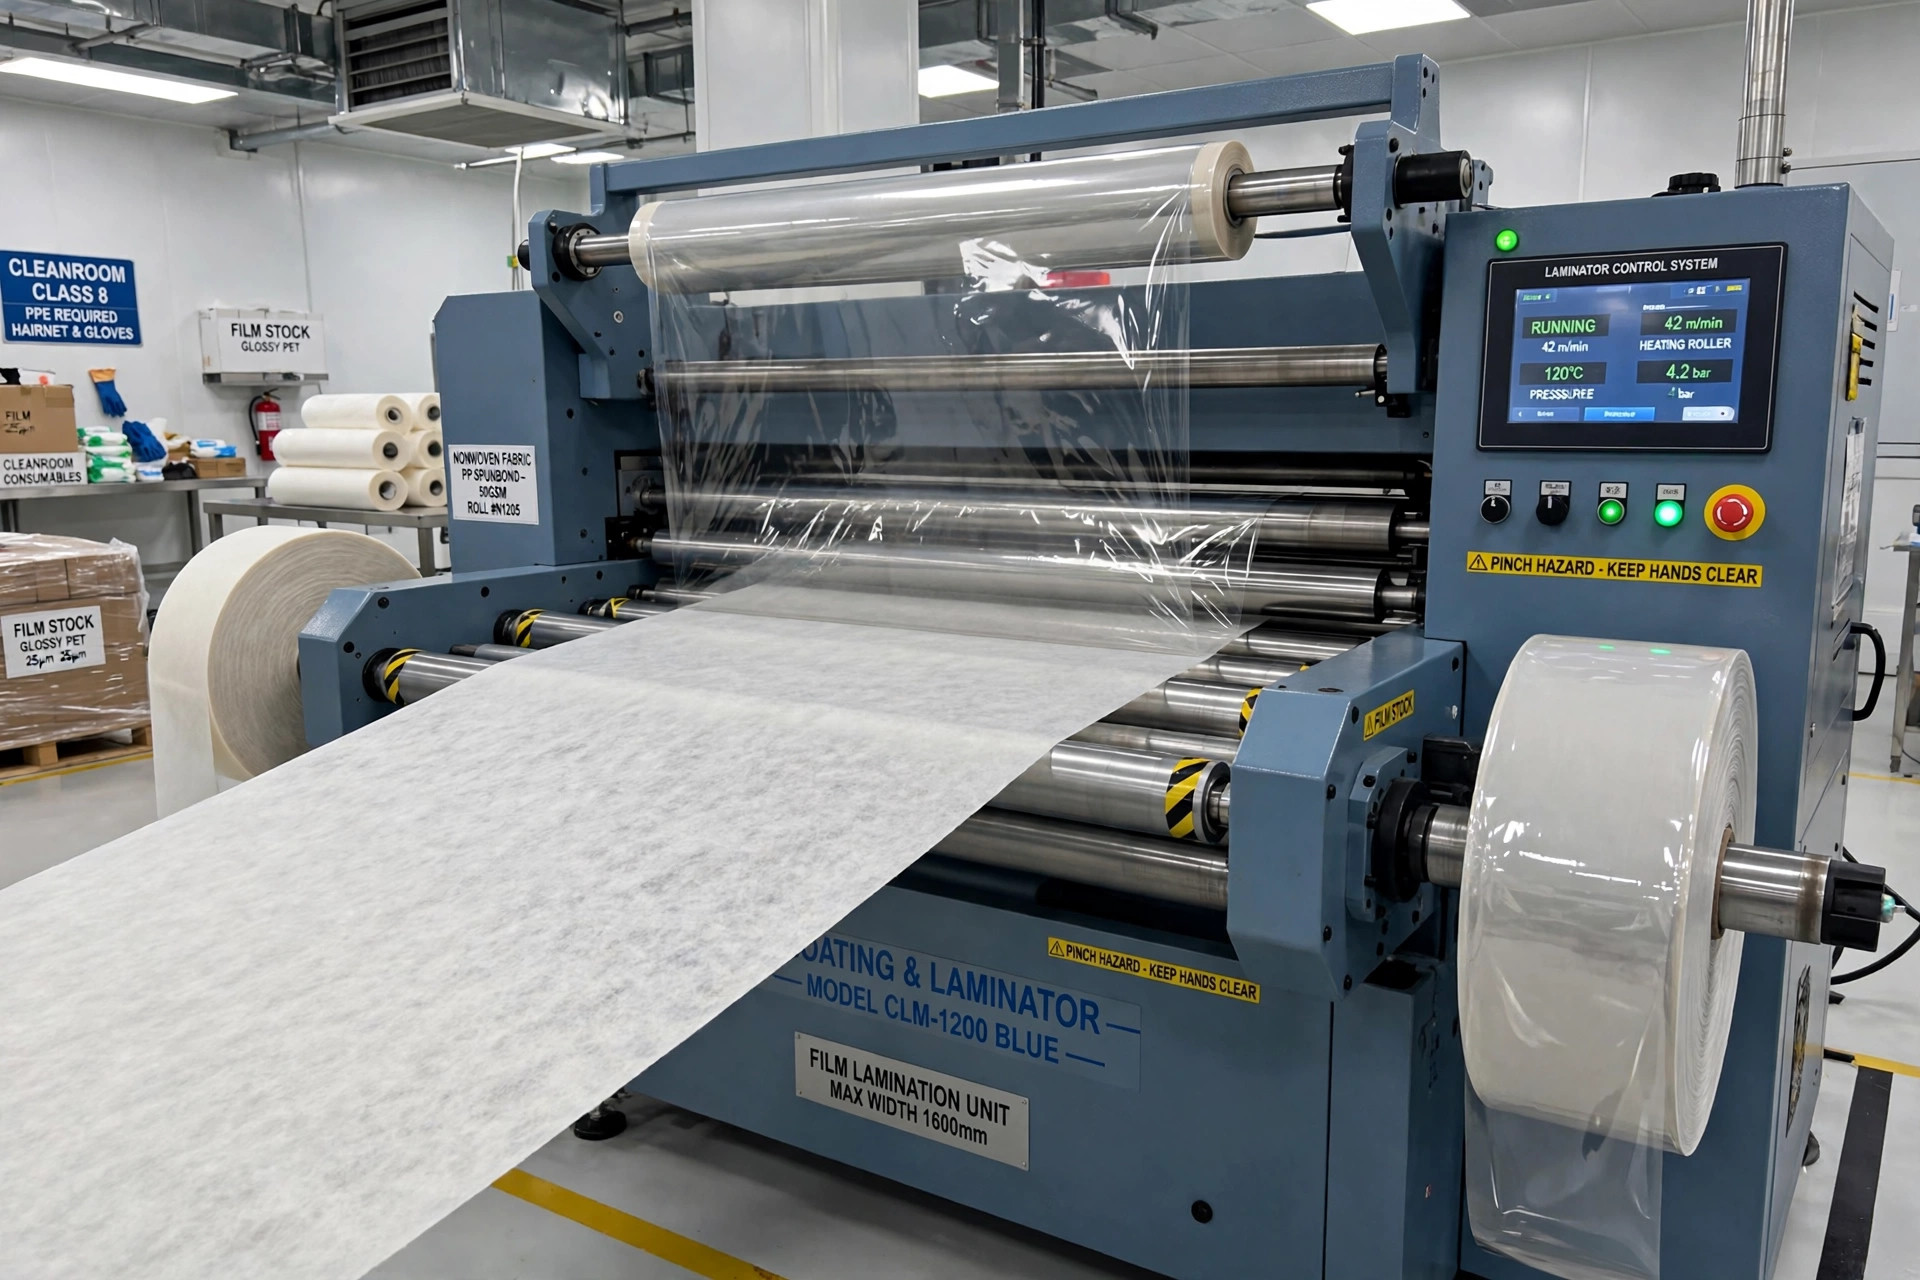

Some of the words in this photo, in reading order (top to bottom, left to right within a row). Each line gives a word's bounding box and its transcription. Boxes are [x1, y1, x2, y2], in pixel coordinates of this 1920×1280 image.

[9, 258, 126, 283] CLEANROOM
[1545, 263, 1609, 278] LAMINATOR
[1612, 261, 1667, 274] CONTROL
[1670, 258, 1718, 271] SYSTEM
[32, 282, 94, 303] CLASS
[98, 287, 109, 304] 8
[25, 306, 51, 321] PPE
[54, 308, 118, 323] REQUIRED
[1664, 315, 1683, 330] 42
[1685, 316, 1723, 330] m/min
[12, 323, 68, 337] HAIRNET
[72, 325, 81, 338] &
[84, 326, 134, 340] GLOVES
[231, 323, 261, 338] FILM
[265, 324, 310, 339] STOCK
[1531, 319, 1596, 334] RUNNING
[241, 341, 280, 352] GLOSSY
[283, 342, 299, 352] PET
[1541, 340, 1556, 353] 42
[1557, 340, 1588, 353] m/min
[1640, 339, 1685, 351] HEATING
[1688, 338, 1731, 350] ROLLER
[1545, 366, 1584, 381] 120°C
[1666, 363, 1690, 379] 4.2
[1692, 367, 1711, 379] bar
[1678, 387, 1695, 399] bar
[6, 410, 30, 421] FILM
[3, 457, 74, 471] CLEANROOM
[453, 451, 500, 466] NONWOVEN
[502, 452, 531, 466] FABRIC
[3, 471, 82, 485] CONSUMABLES
[462, 468, 472, 480] PP
[479, 486, 507, 499] 50GSM
[467, 501, 489, 515] ROLL
[491, 503, 520, 516] #N1205
[1490, 556, 1532, 572] PINCH
[1536, 558, 1595, 575] HAZARD
[1607, 562, 1645, 578] KEEP
[1649, 563, 1702, 581] HANDS
[1706, 566, 1757, 584] CLEAR
[14, 621, 45, 638] FILM
[49, 614, 94, 633] STOCK
[20, 637, 62, 652] GLOSSY
[66, 634, 86, 646] PET
[1066, 944, 1096, 964] PINCH
[1099, 953, 1140, 973] HAZARD
[1150, 963, 1177, 981] KEEP
[1179, 970, 1216, 991] HANDS
[1219, 979, 1257, 1000] CLEAR
[797, 936, 894, 982] OATING
[903, 955, 921, 988] &
[931, 962, 1100, 1035] LAMINATOR
[807, 973, 878, 1014] MODEL
[884, 994, 988, 1043] CLM-1200
[995, 1022, 1059, 1064] BLUE
[810, 1047, 848, 1078] FILM
[853, 1060, 960, 1112] LAMINATION
[966, 1093, 1010, 1126] UNIT
[830, 1079, 864, 1107] MAX
[867, 1090, 918, 1123] WIDTH
[923, 1108, 988, 1145] 1600mm
